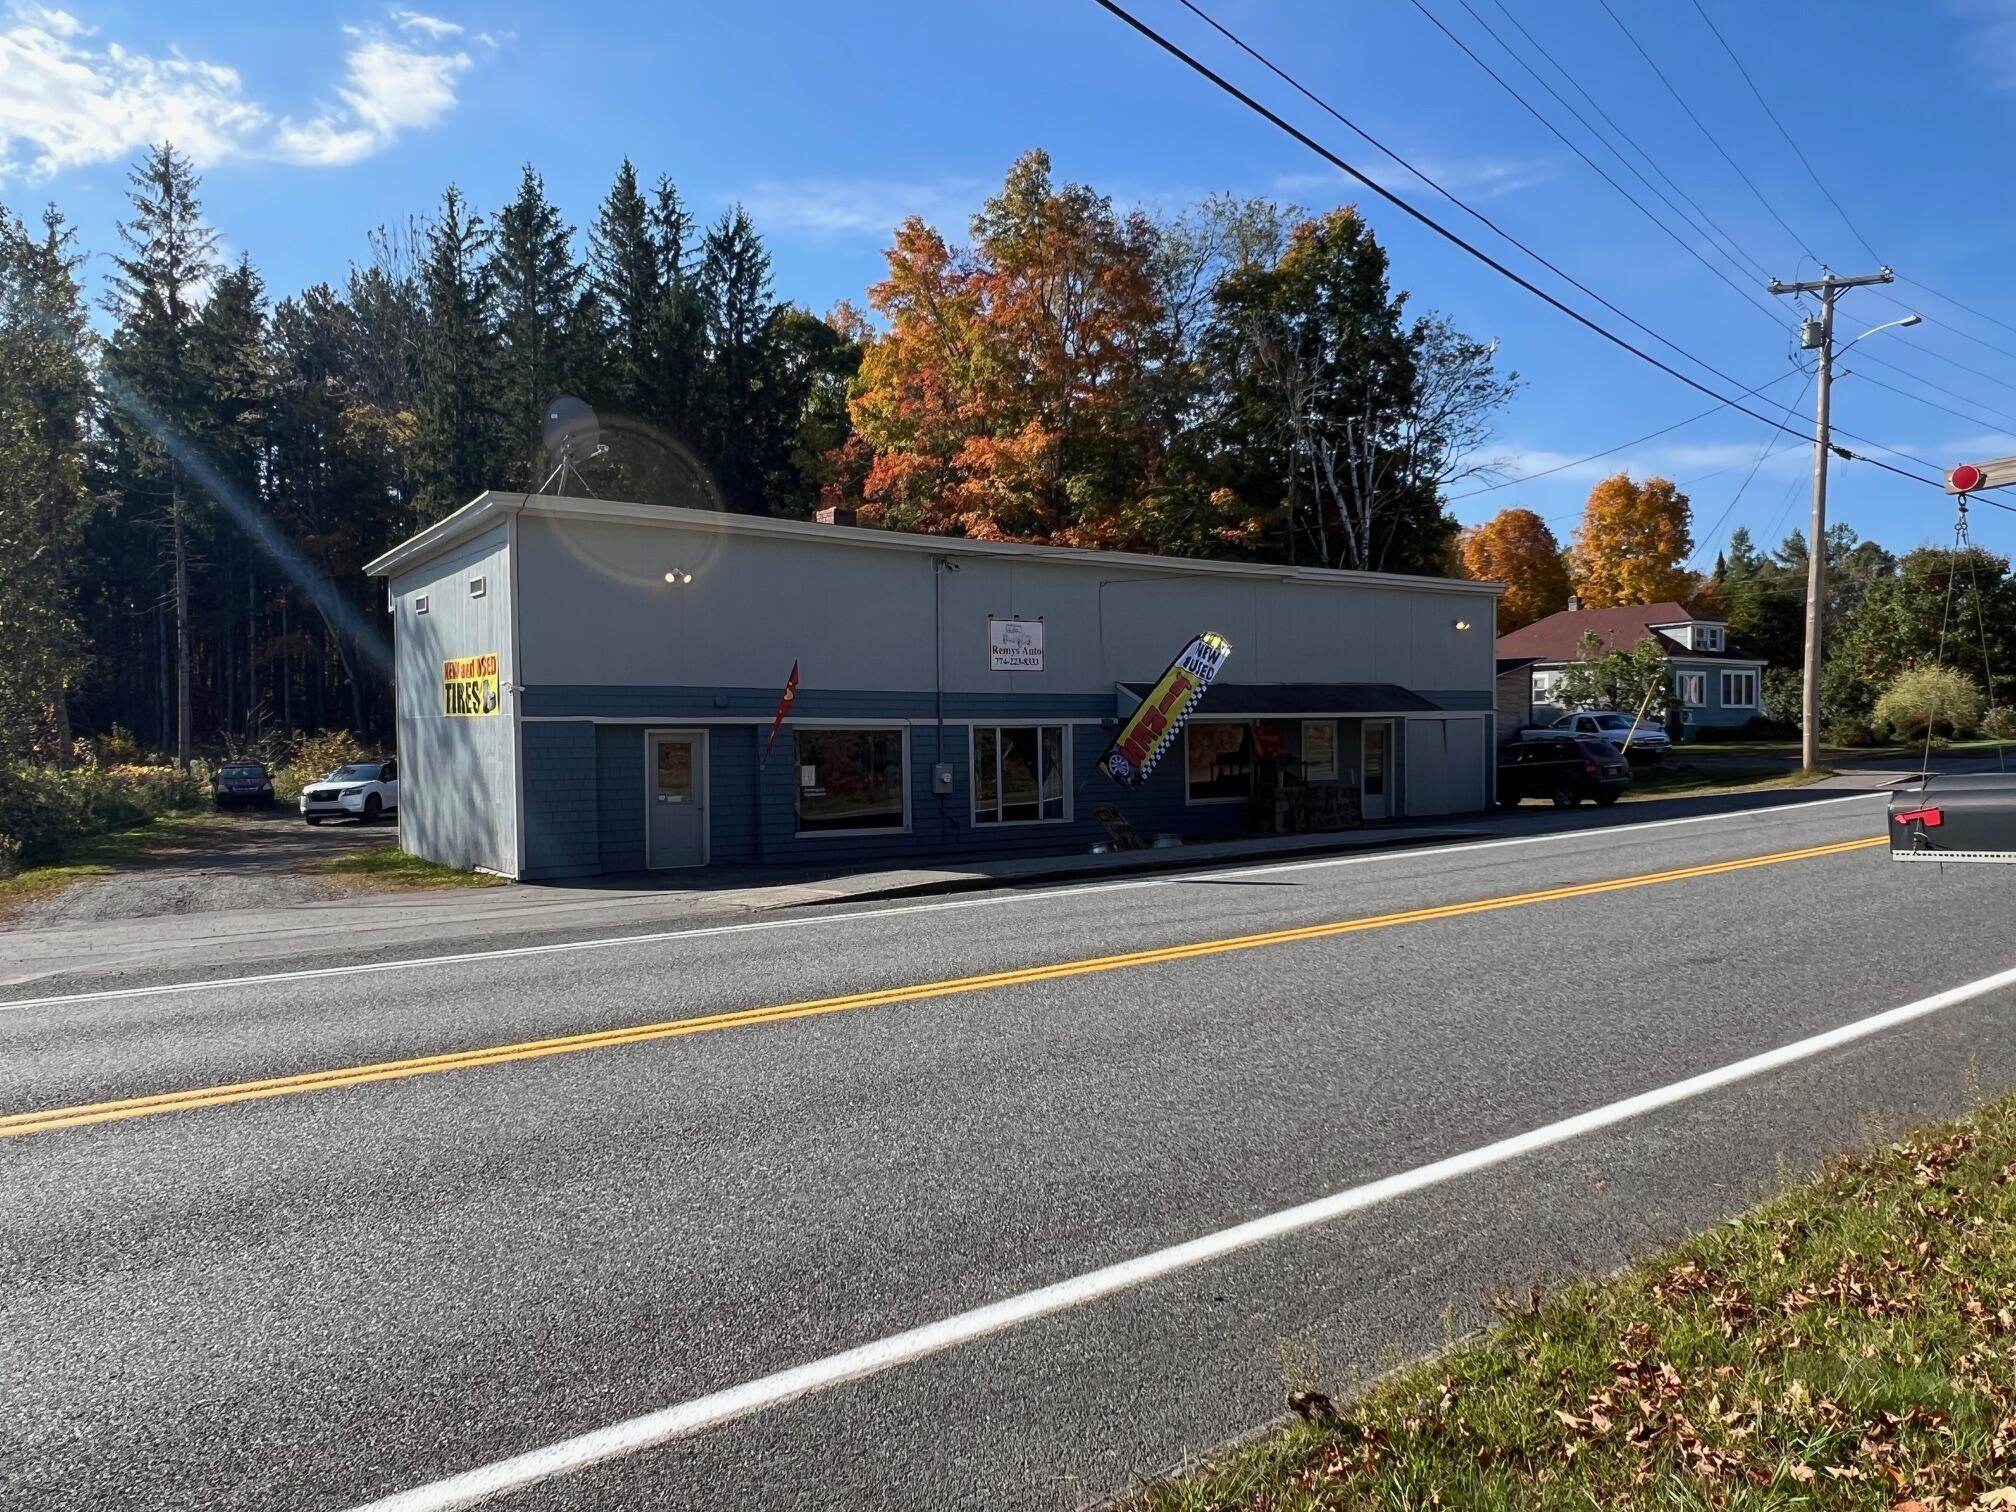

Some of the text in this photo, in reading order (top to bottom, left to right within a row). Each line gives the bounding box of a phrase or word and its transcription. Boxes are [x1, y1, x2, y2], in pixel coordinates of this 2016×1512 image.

[1022, 646, 1042, 656] Auto
[1196, 642, 1221, 664] NEW
[444, 656, 497, 680] NEW and USED
[445, 681, 481, 714] TIRES
[1119, 671, 1192, 768] TIRES
